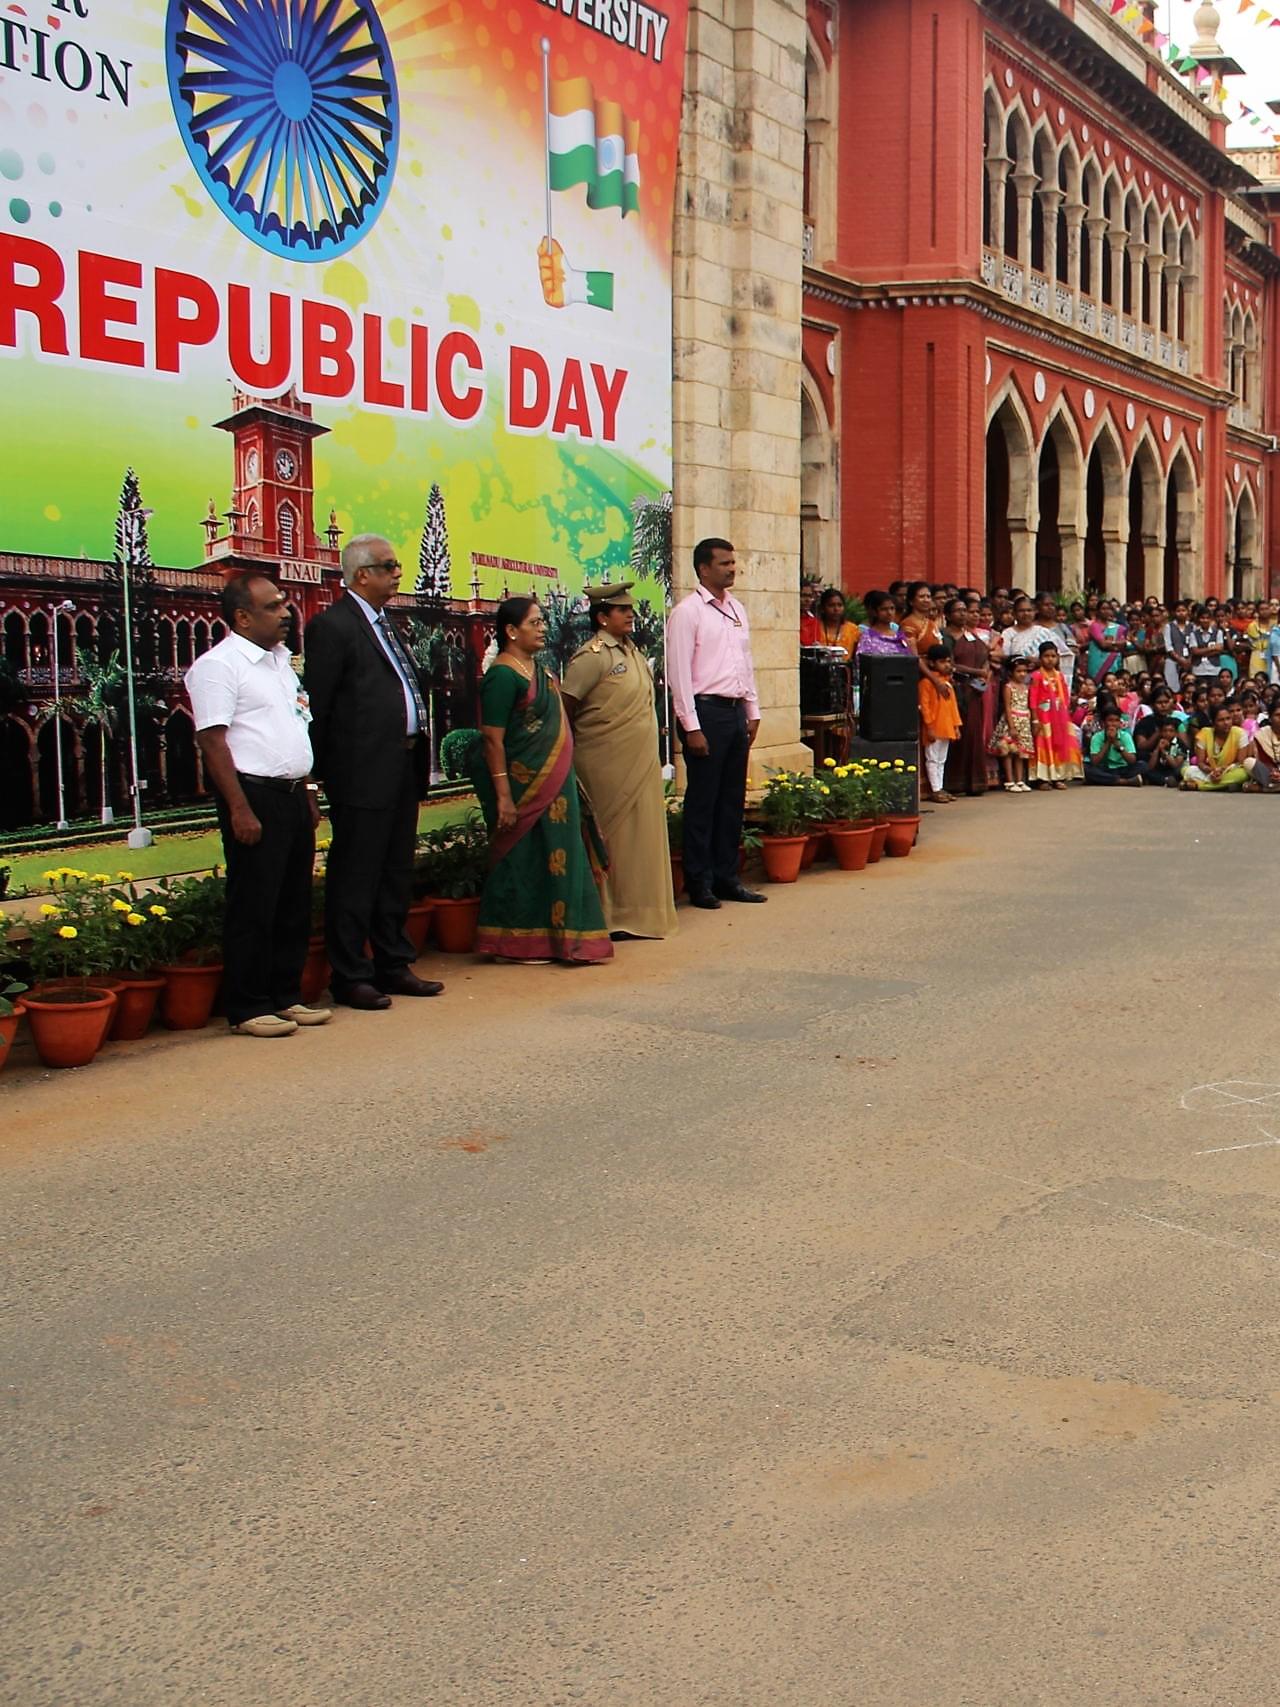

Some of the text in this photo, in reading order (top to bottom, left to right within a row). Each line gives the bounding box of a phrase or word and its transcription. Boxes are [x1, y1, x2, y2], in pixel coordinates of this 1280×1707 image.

[0, 16, 133, 107] TION
[0, 231, 629, 442] REPUBLIC DAY
